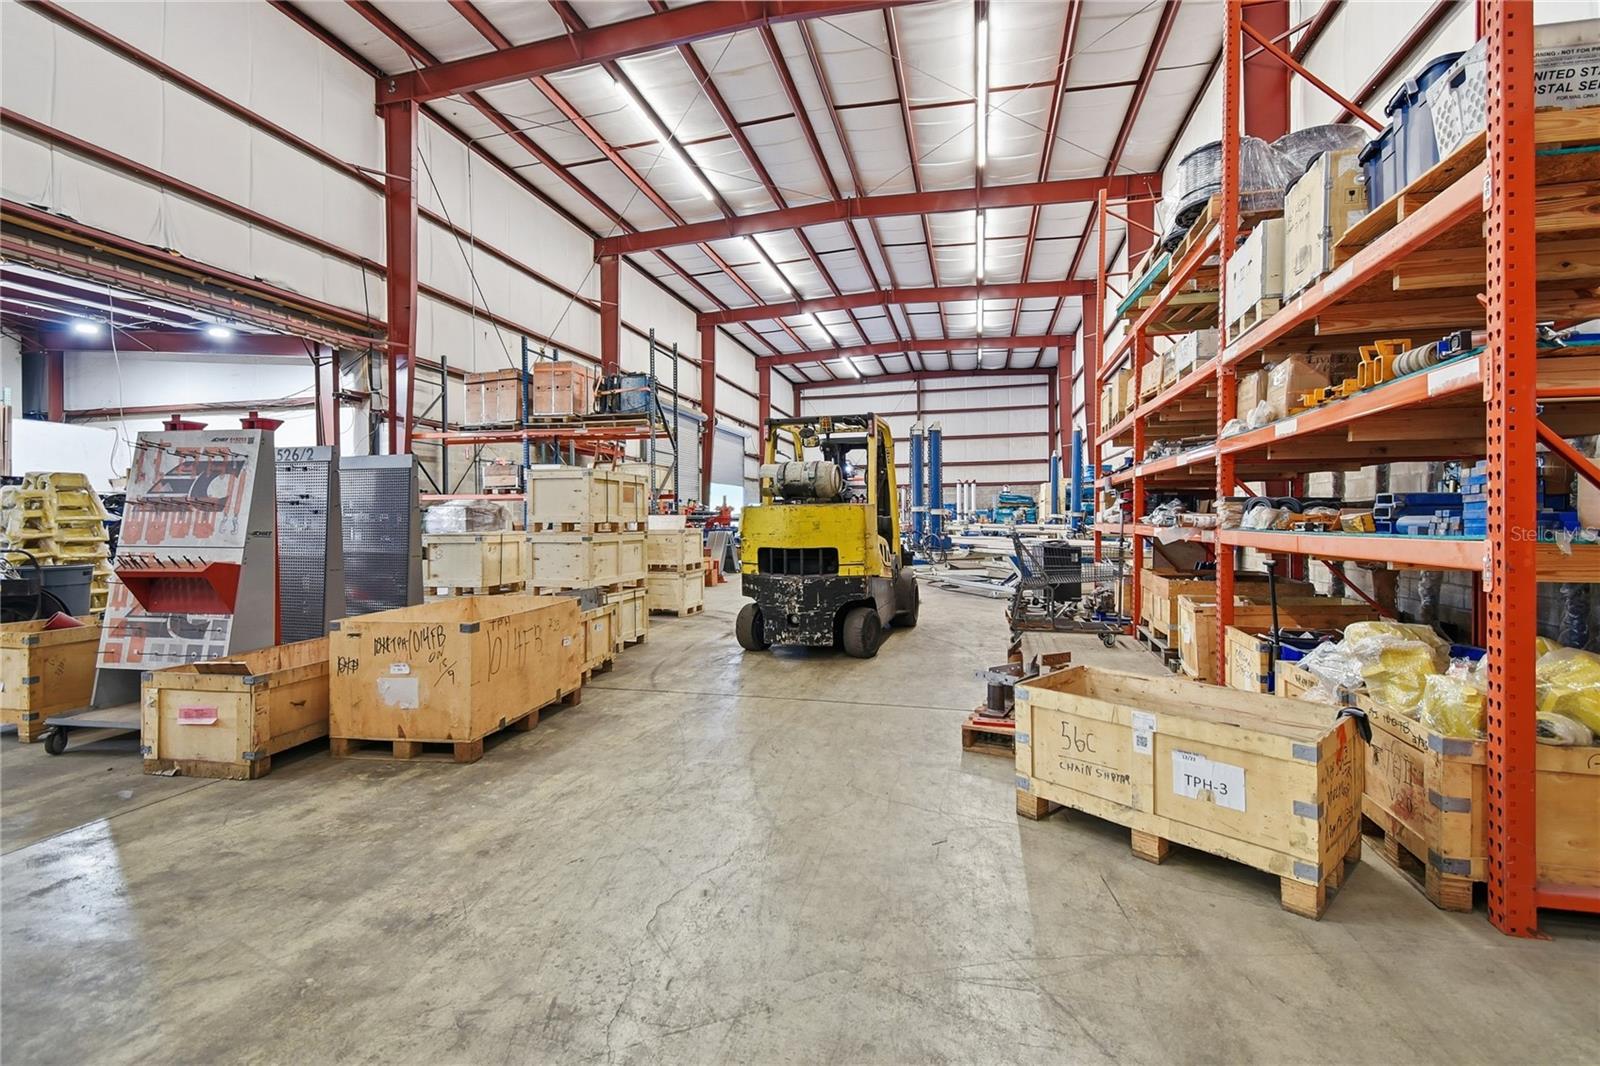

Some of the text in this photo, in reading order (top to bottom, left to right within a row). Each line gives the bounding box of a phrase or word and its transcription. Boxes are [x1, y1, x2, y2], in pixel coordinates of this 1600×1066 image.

[1534, 65, 1600, 81] NITED ST
[1534, 80, 1600, 95] STAL SE
[277, 447, 314, 462] 526/2
[1061, 720, 1097, 753] 56C
[1059, 761, 1092, 777] CHAIN
[1183, 773, 1229, 796] TPH-3
